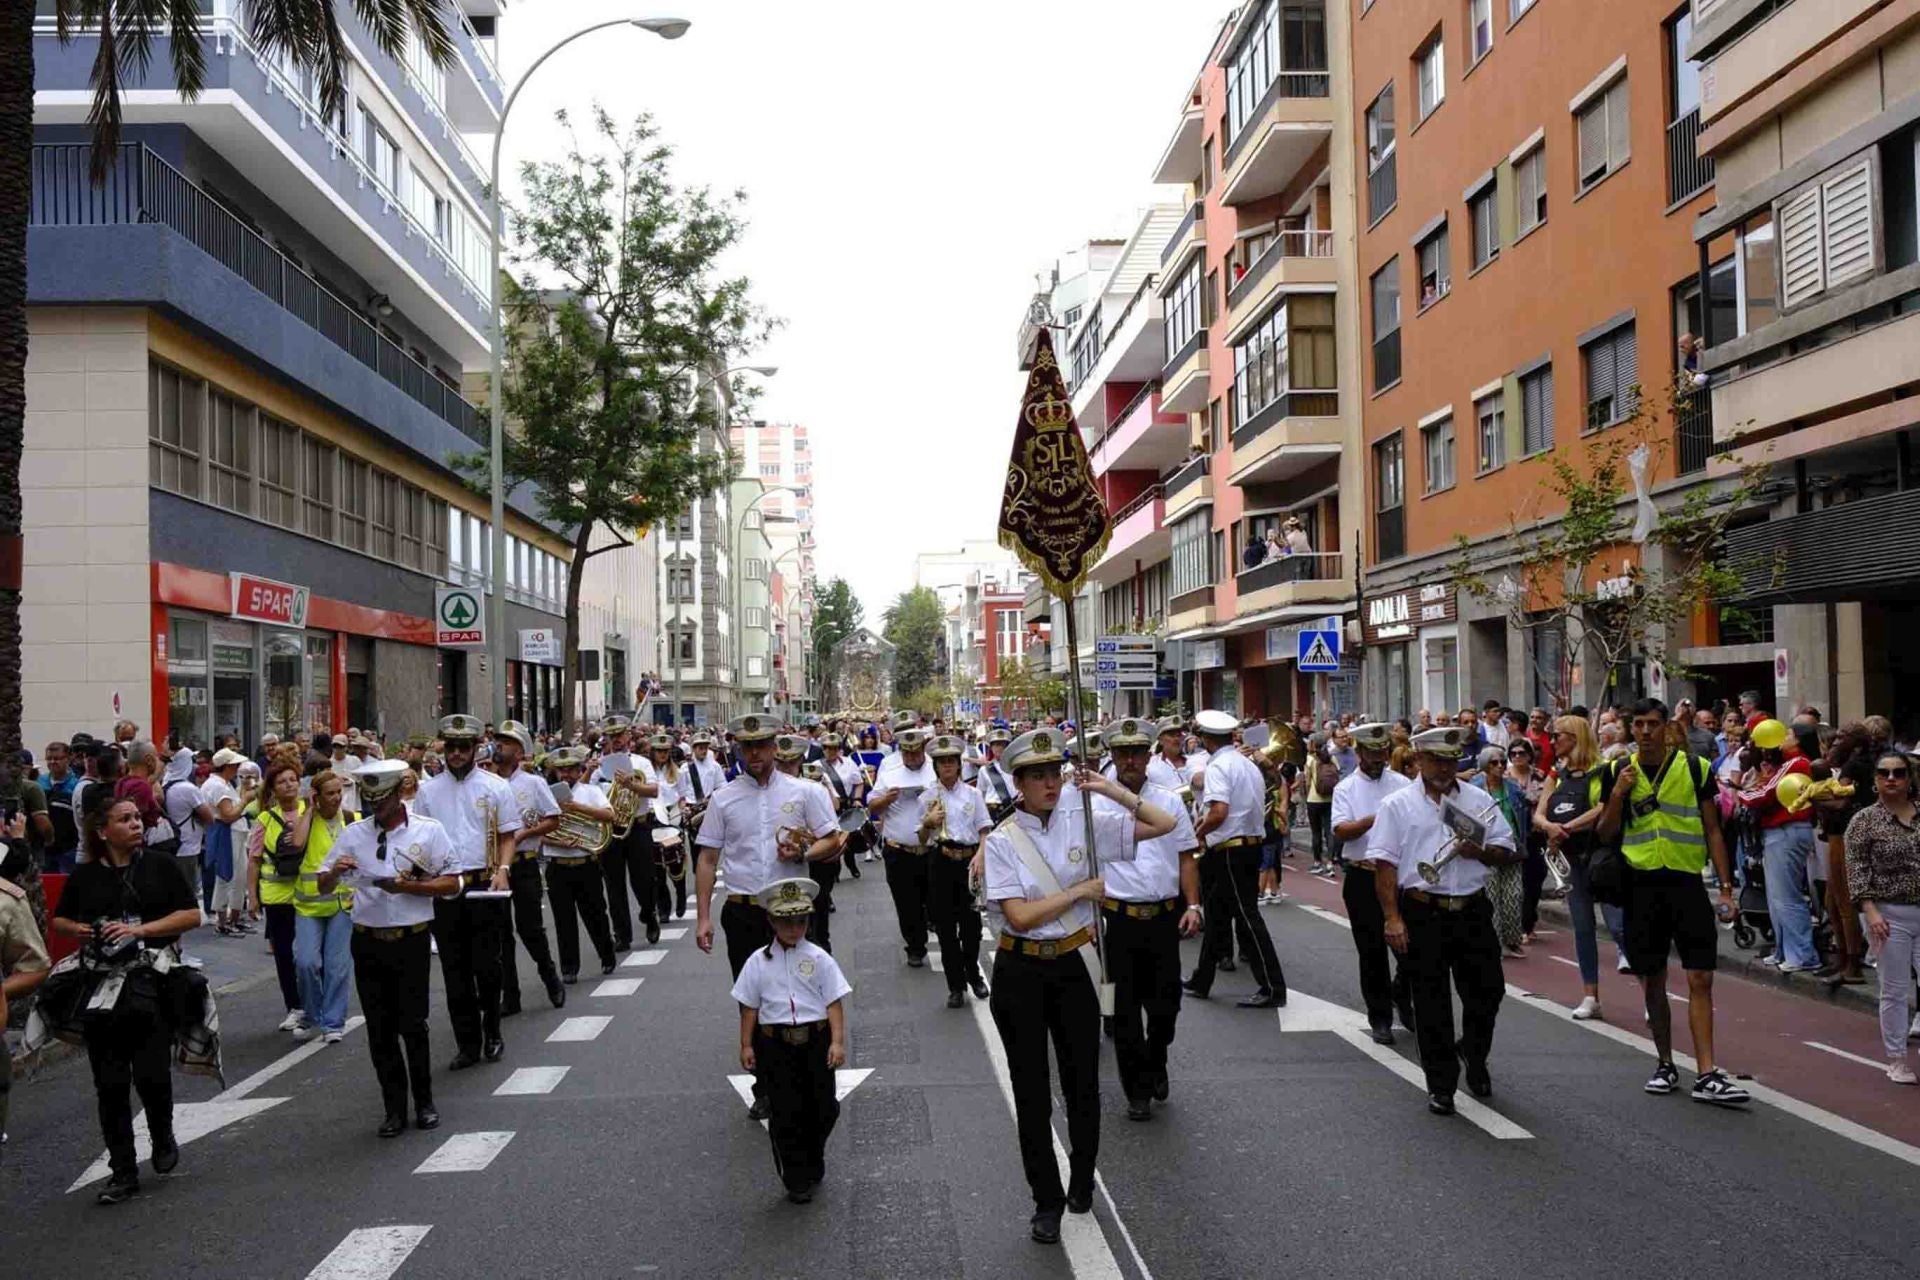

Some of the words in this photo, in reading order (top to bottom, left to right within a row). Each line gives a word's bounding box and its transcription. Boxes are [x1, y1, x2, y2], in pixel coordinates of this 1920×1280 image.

[250, 587, 292, 616] SPAR
[1369, 594, 1409, 626] ADALIA
[441, 632, 481, 642] SPAR
